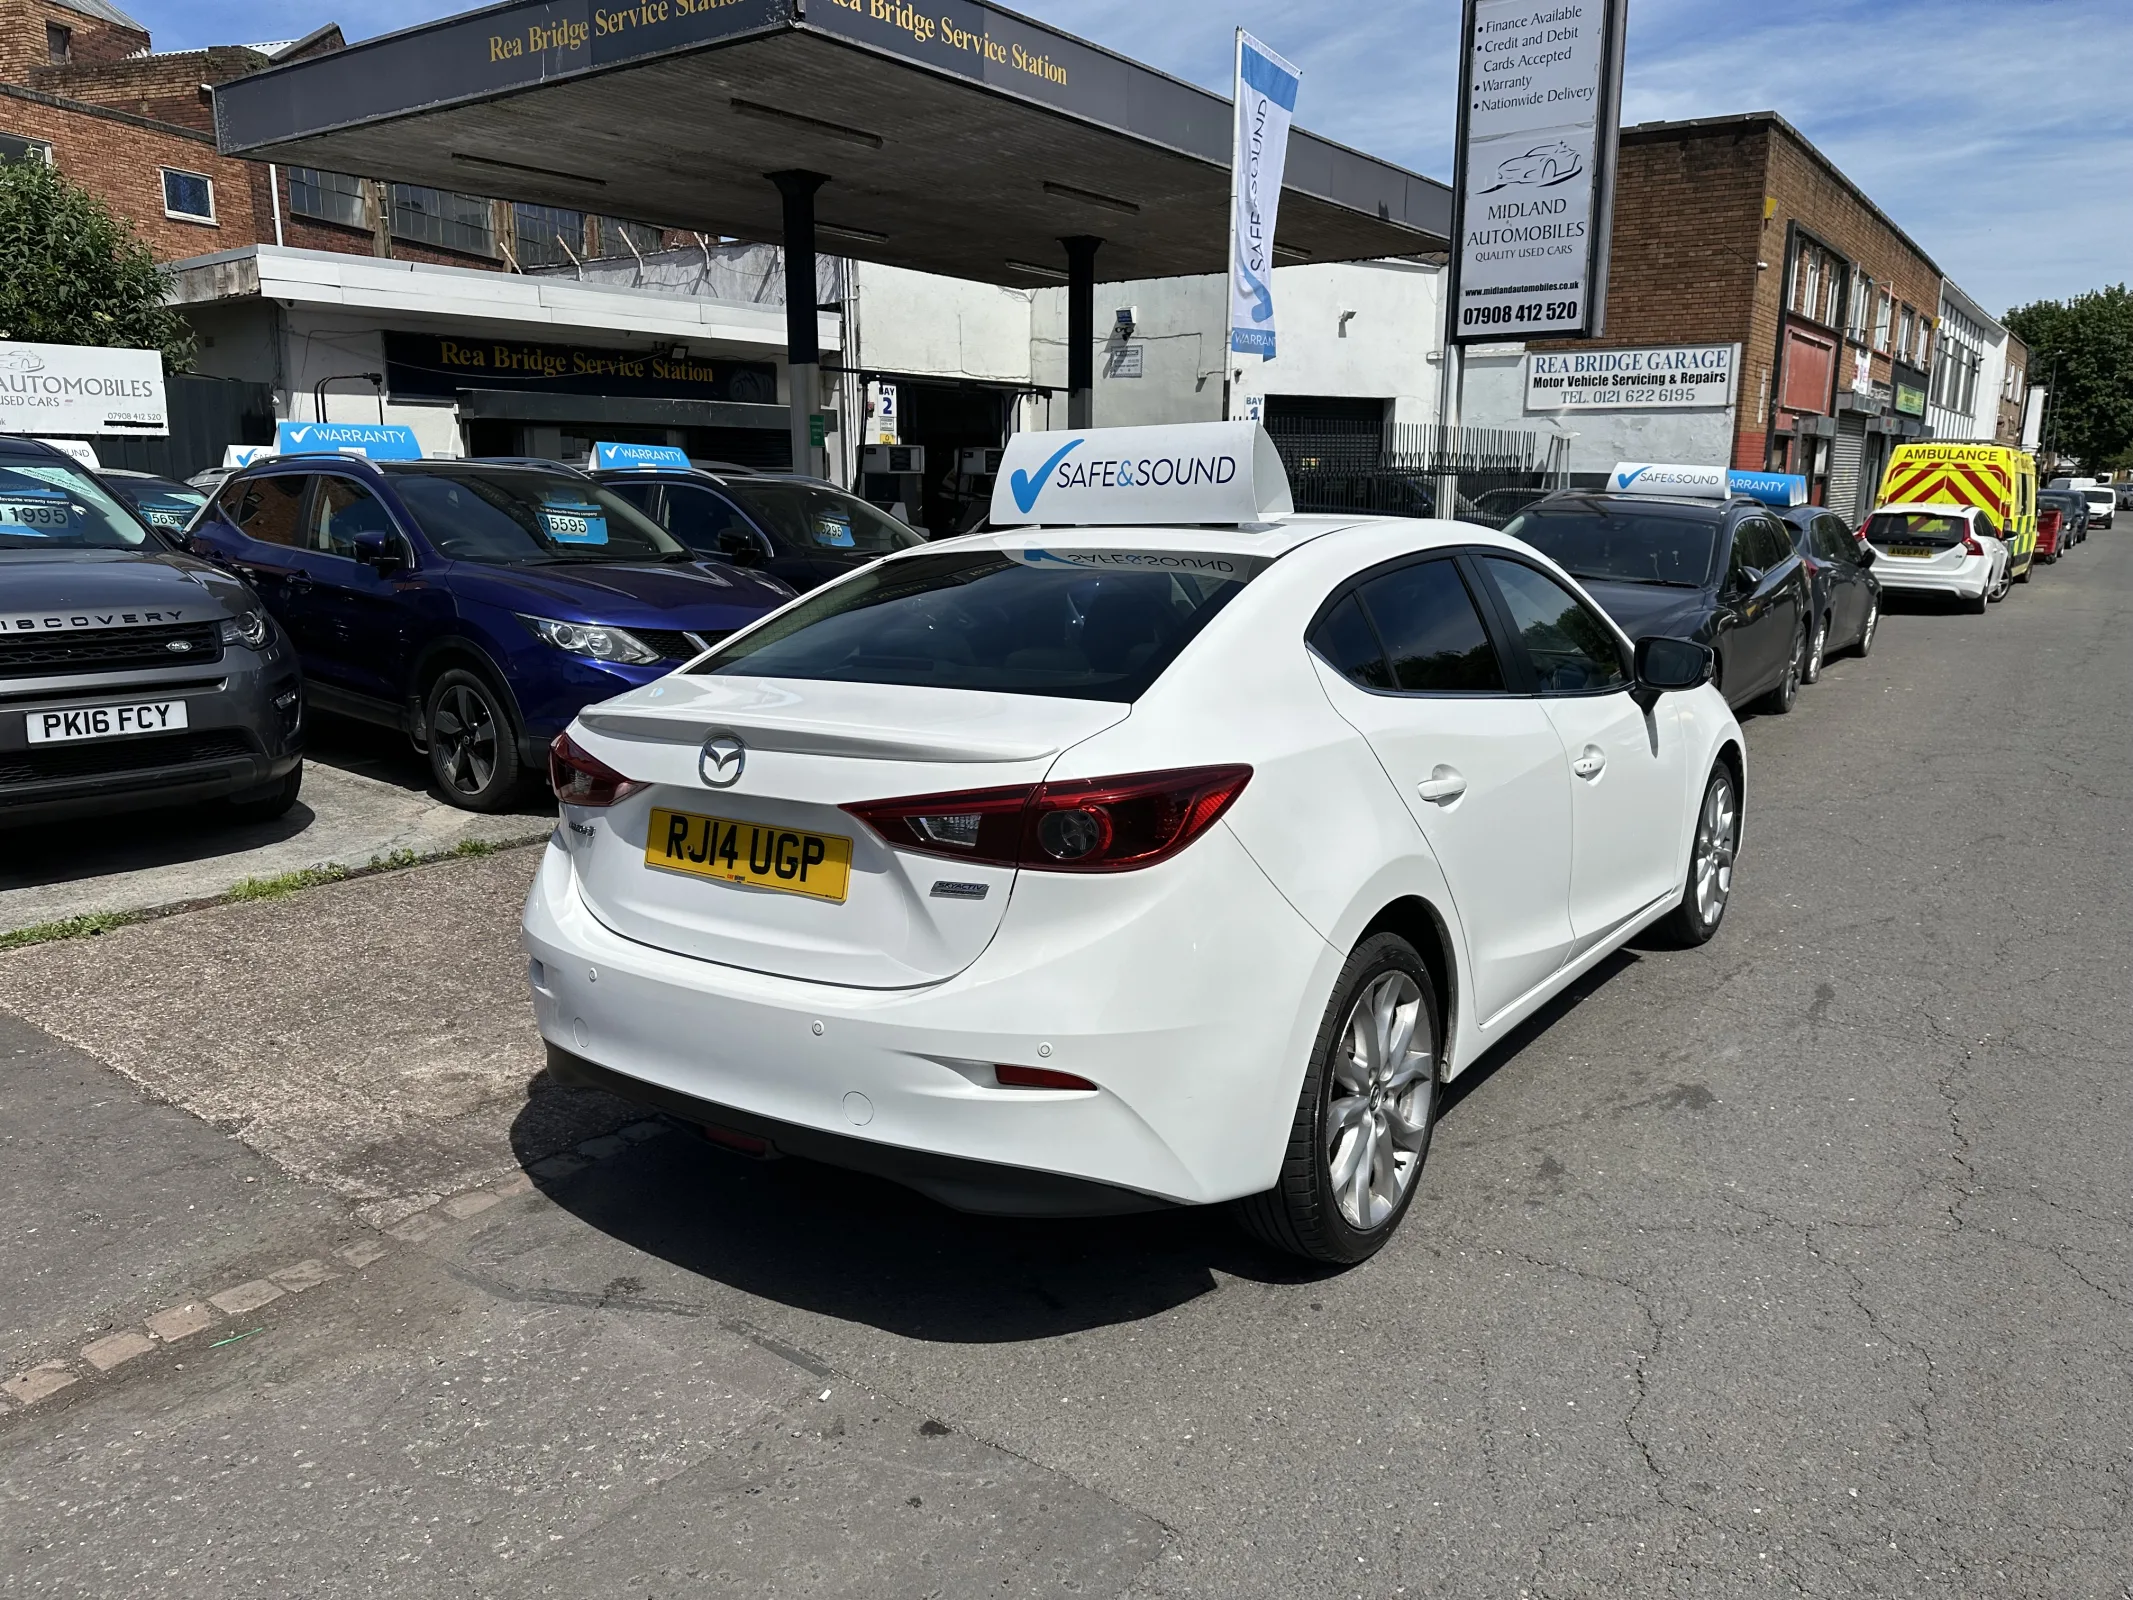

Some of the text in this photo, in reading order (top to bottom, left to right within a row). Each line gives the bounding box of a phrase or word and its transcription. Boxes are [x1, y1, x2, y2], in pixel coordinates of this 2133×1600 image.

[1486, 5, 1582, 34] Finance Available
[490, 35, 523, 63] Rea
[528, 18, 590, 53] Bridge
[594, 0, 669, 37] Service
[1484, 27, 1579, 53] Credit and Debit
[868, 0, 936, 42] Bridge
[940, 16, 1007, 64] Service
[1011, 43, 1068, 86] Station
[1483, 46, 1572, 72] Cards Accepted
[1483, 75, 1533, 92] Warranty
[1481, 86, 1596, 112] Nationwide Delivery
[1487, 198, 1567, 221] MIDLAND
[1467, 221, 1585, 247] AUTOMOBILES
[1475, 244, 1573, 263] QUALITY USED CARS
[1465, 280, 1579, 297] www.midlandautomobiles.co.uk
[1463, 301, 1578, 326] 07908 412 520
[439, 341, 714, 383] Rea Bridge Service Station
[1535, 349, 1728, 374] REA BRIDGE GARAGE
[1533, 371, 1726, 389] Motor Vehicle Servicing & Repairs
[28, 396, 60, 407] CARS
[1246, 396, 1263, 405] BAY
[1561, 388, 1696, 404] TEL. 0121 622 6195
[882, 397, 892, 415] 2
[1250, 406, 1259, 420] 1
[108, 412, 131, 420] 07908
[147, 413, 162, 421] 520
[313, 428, 406, 444] WARRANTY
[620, 447, 681, 462] WARRANTY
[1904, 448, 1998, 462] AMBULANCE
[1056, 456, 1236, 489] SAFE&SOUND
[1639, 472, 1719, 486] SAFE&SOUND
[1729, 478, 1786, 492] ARRANTY
[152, 513, 184, 525] 5695
[550, 517, 587, 533] 5595
[0, 610, 183, 631] ISCOVERY
[43, 704, 170, 739] PK16 FCY
[666, 814, 825, 883] RJ14 UGP
